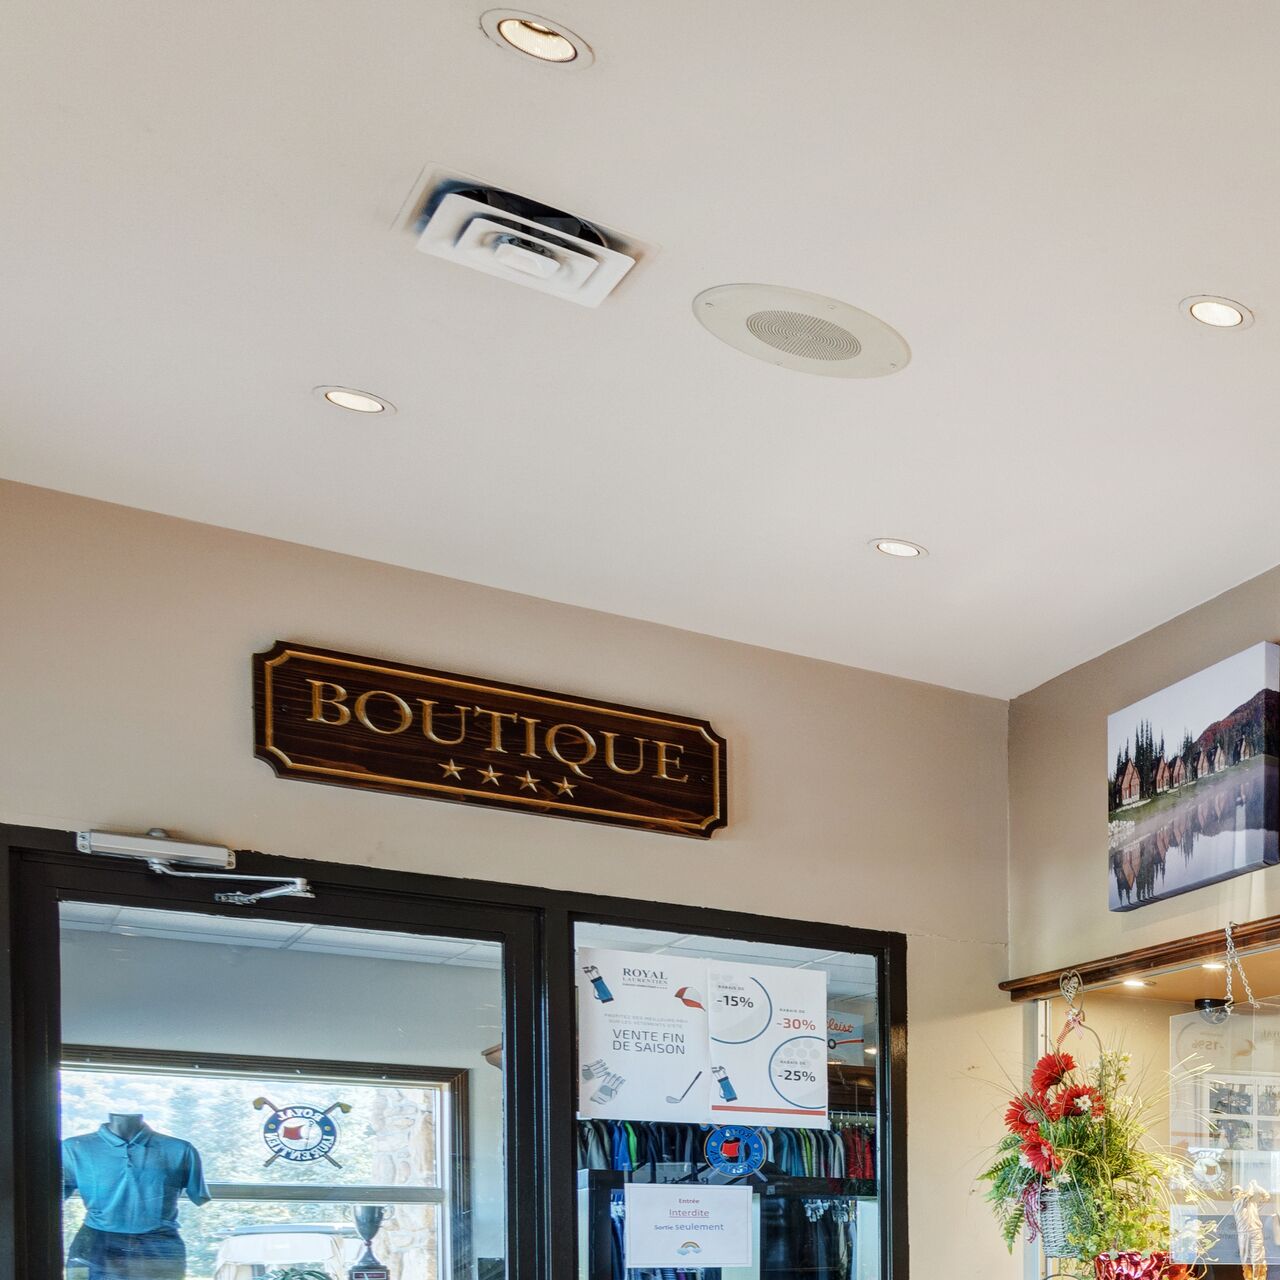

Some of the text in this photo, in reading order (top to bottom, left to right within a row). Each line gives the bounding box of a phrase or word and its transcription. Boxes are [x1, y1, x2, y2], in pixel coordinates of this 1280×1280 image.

[305, 678, 689, 783] BOUTIQUE
[623, 968, 668, 980] ROYAL
[716, 995, 754, 1008] -15%
[776, 1018, 816, 1031] -30%
[612, 1028, 685, 1043] VENTE FIN
[612, 1041, 685, 1055] DE SAISON
[777, 1070, 816, 1083] -25%
[669, 1209, 709, 1217] Interdite
[675, 1223, 724, 1231] seulement
